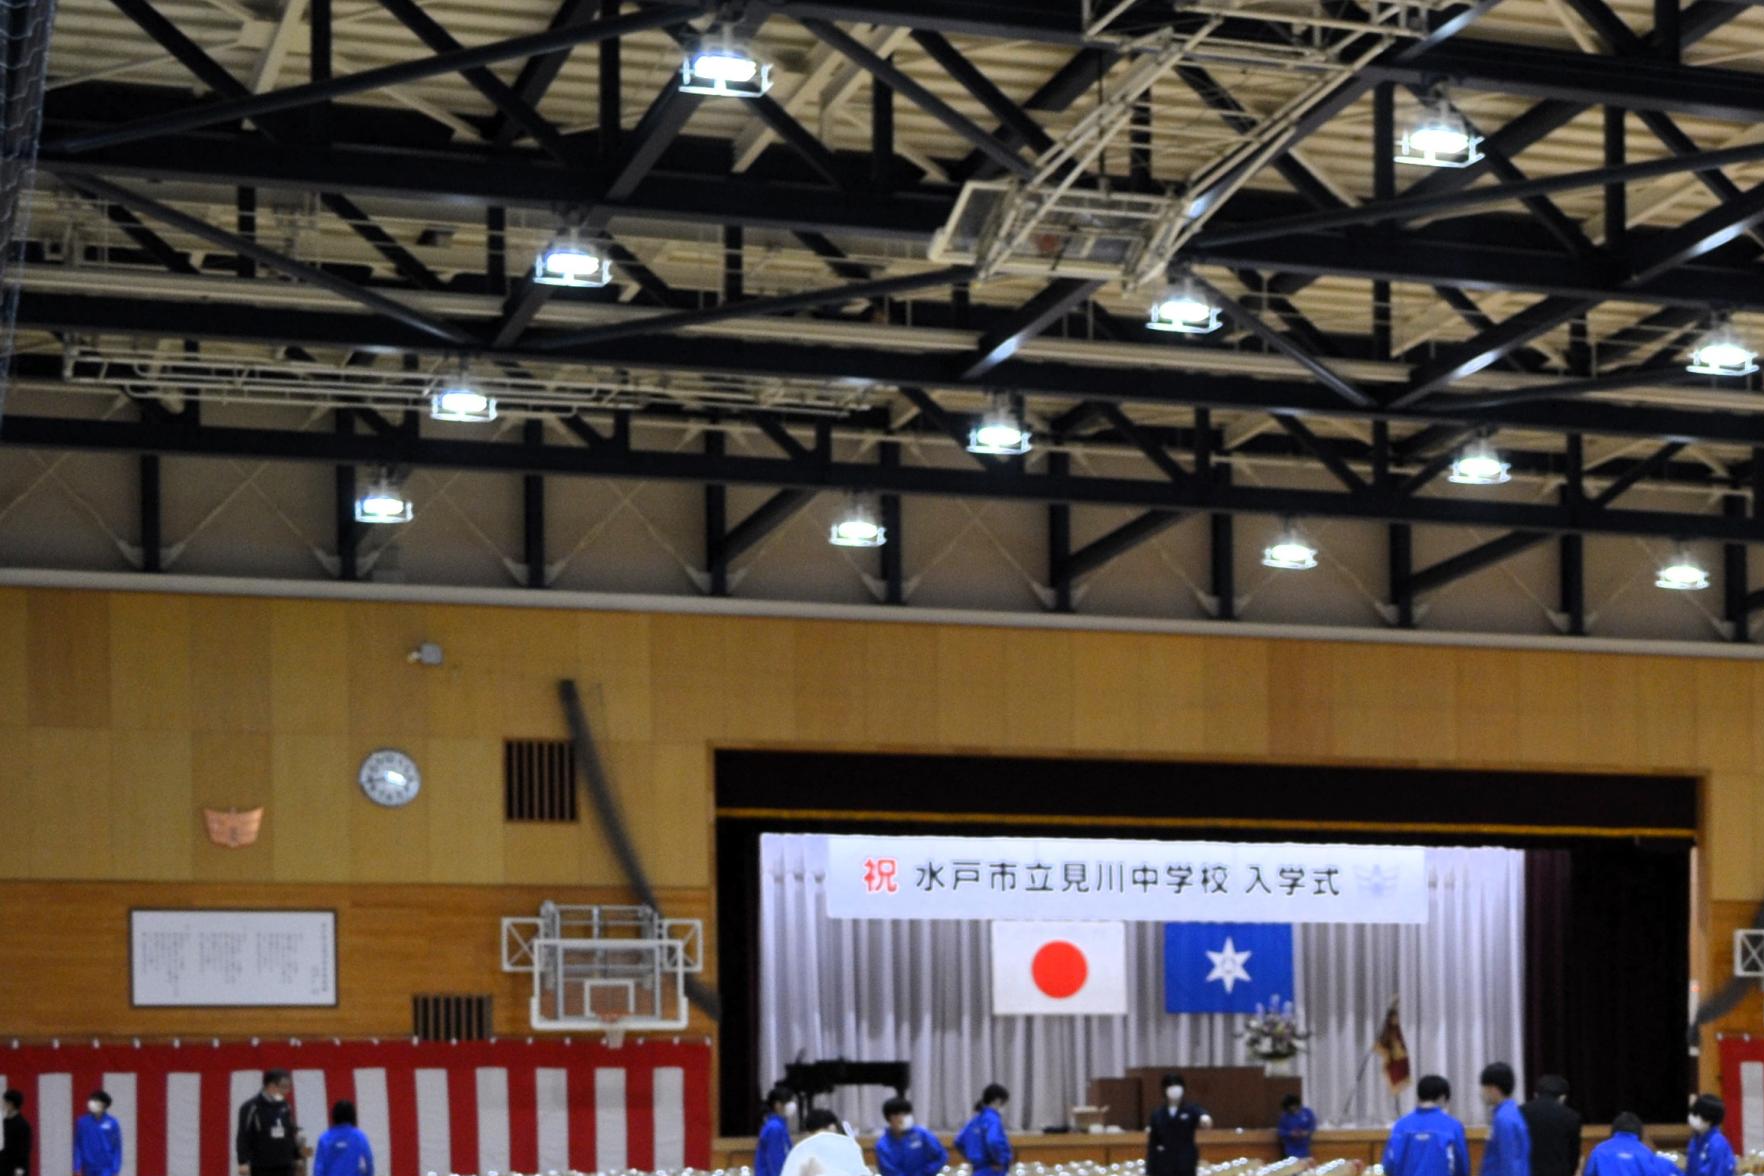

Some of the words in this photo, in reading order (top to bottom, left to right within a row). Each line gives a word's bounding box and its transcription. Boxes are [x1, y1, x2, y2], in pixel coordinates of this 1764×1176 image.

[864, 859, 898, 893] 祝
[916, 861, 1228, 895] 水戸市立見川中学校
[1245, 865, 1340, 896] 入学式
